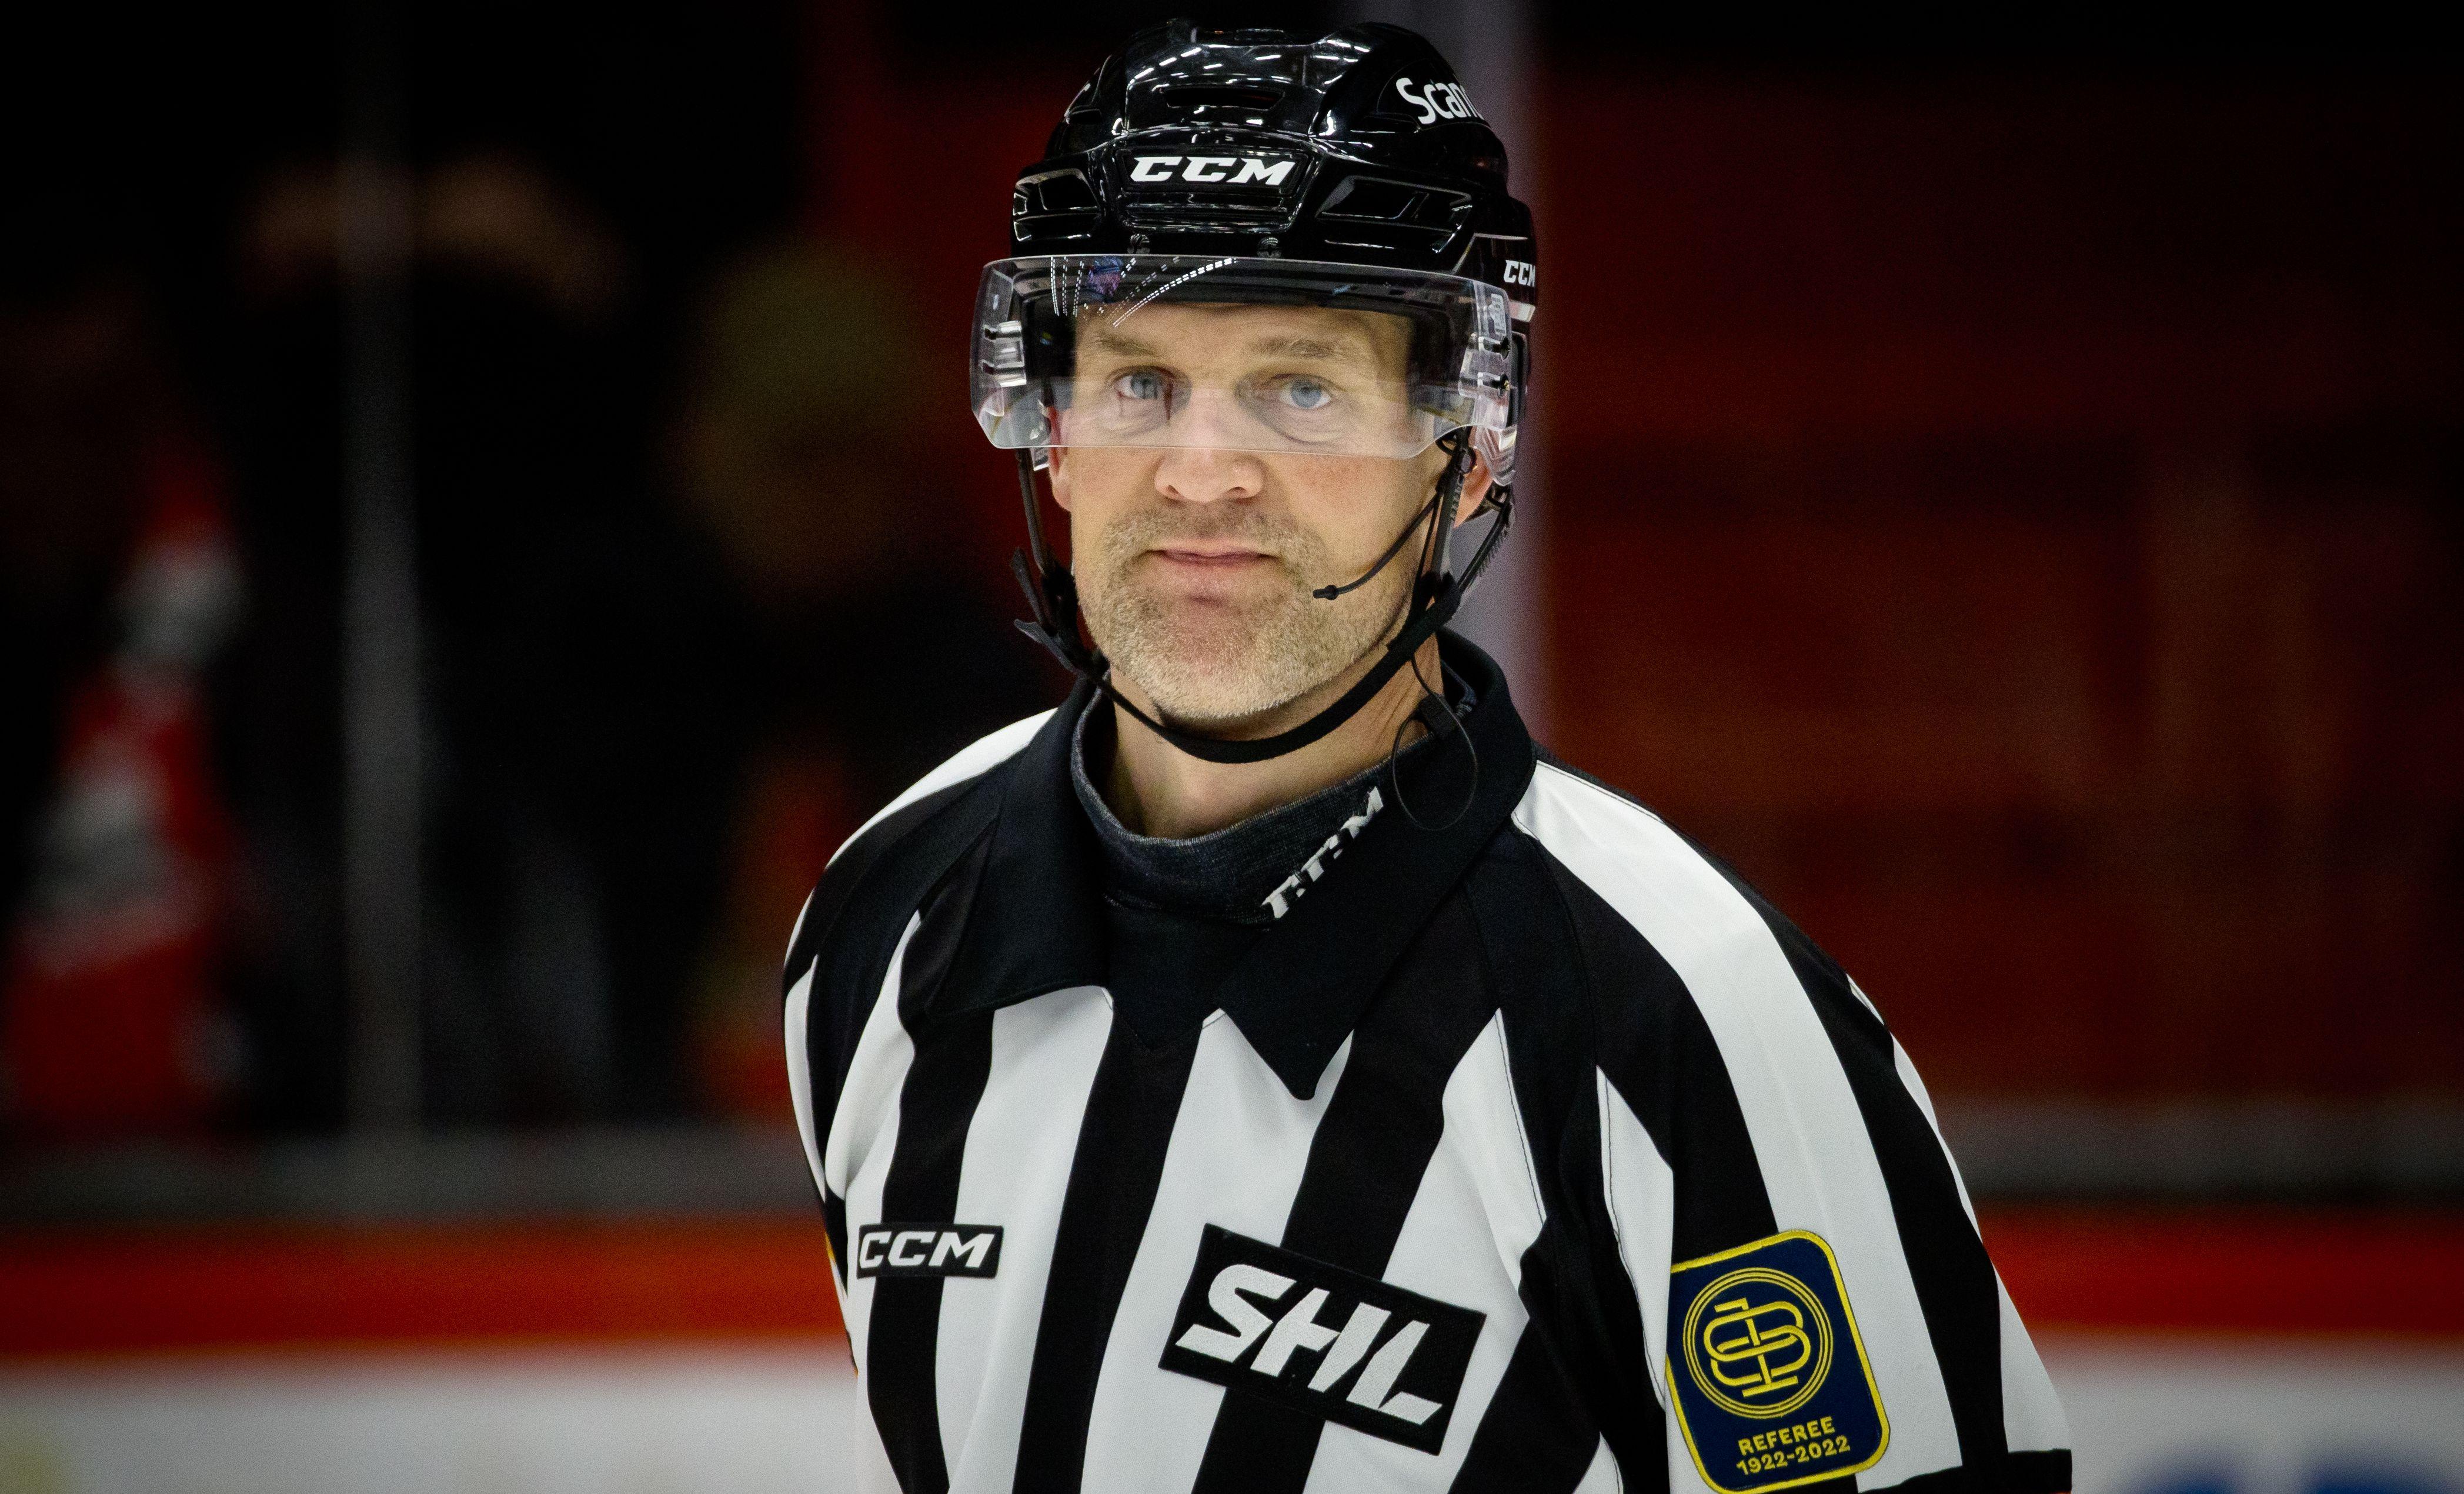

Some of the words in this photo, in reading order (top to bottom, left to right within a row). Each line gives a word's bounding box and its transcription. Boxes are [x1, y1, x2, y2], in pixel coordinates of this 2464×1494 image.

[1395, 78, 1484, 124] Scan
[1130, 156, 1296, 186] CCM
[1503, 259, 1536, 287] CCM
[859, 1230, 995, 1269] CCM
[1175, 1264, 1443, 1425] SHL
[1736, 1435, 1851, 1475] 1922-2022
[1737, 1416, 1835, 1456] REFEREE
